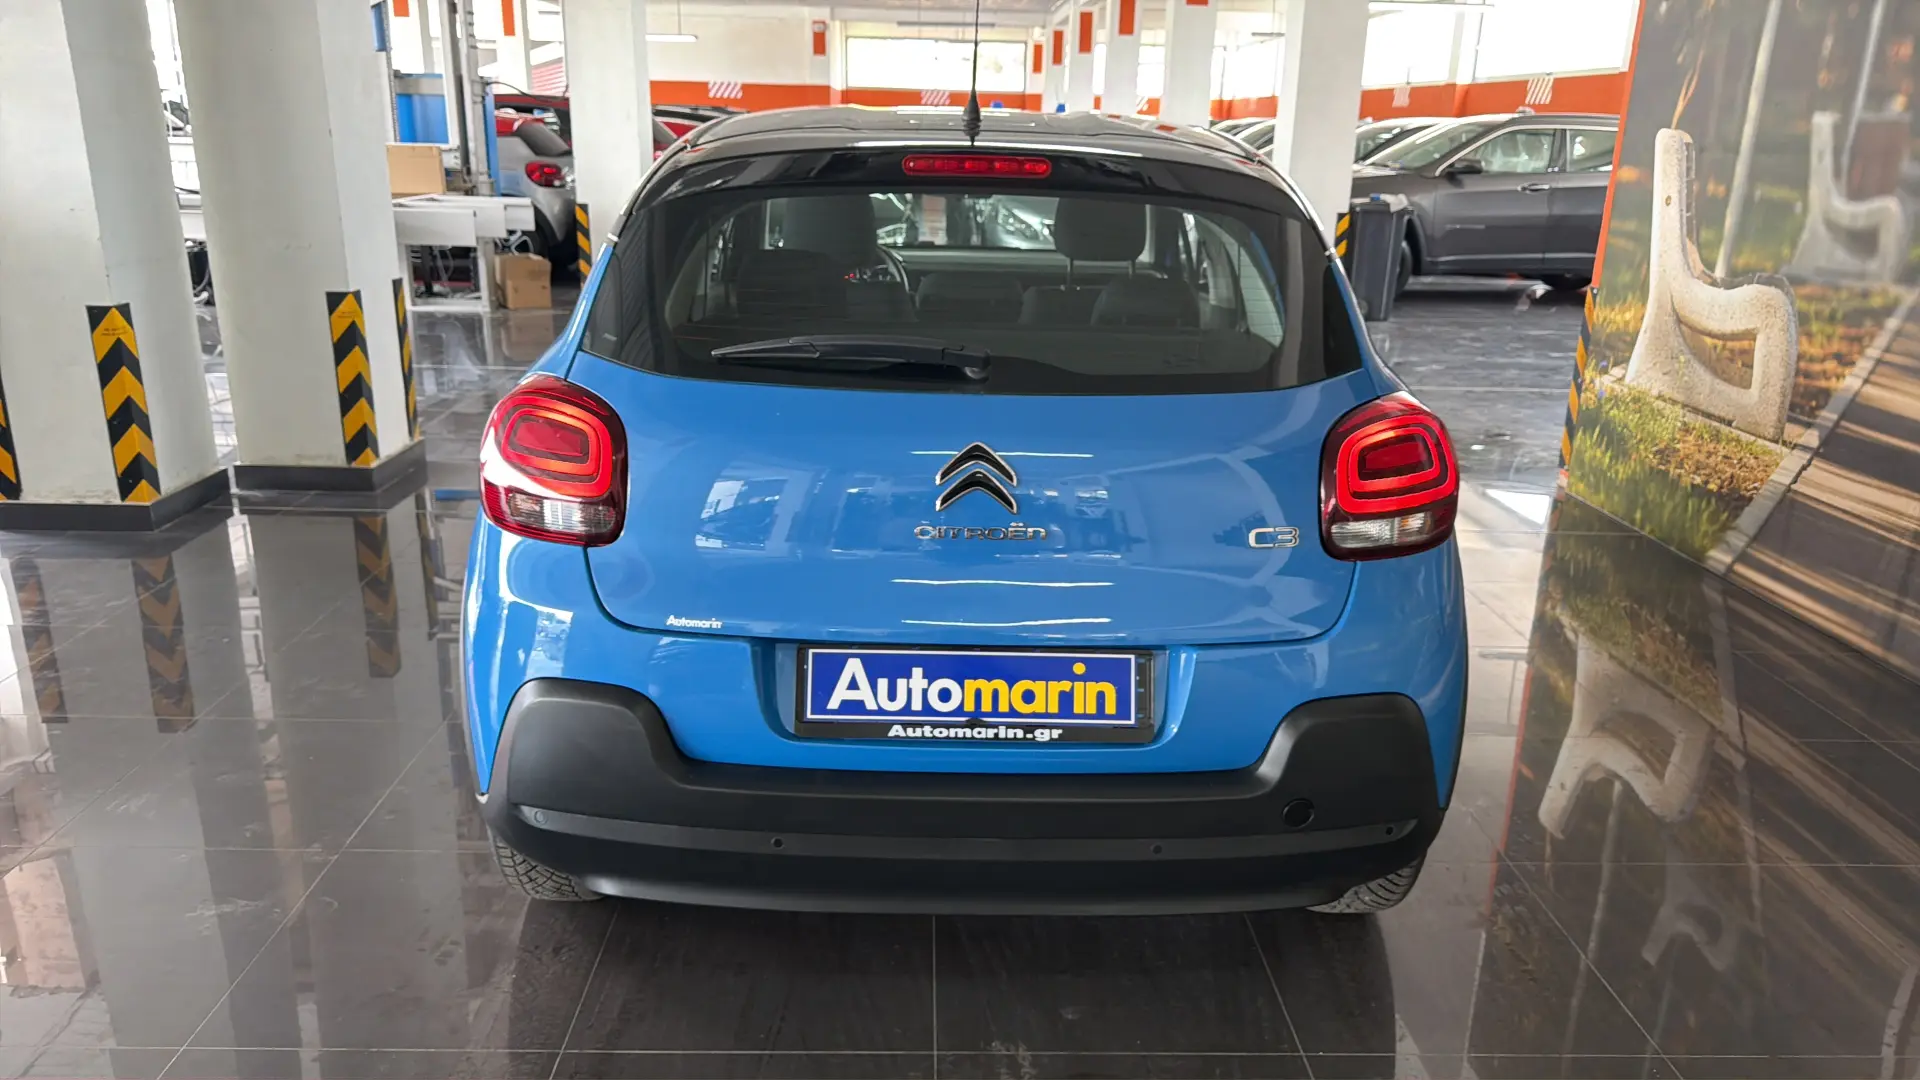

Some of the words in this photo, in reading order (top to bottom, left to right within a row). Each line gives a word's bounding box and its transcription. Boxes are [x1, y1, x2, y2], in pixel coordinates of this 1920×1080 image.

[1249, 527, 1299, 548] C3
[666, 615, 722, 628] Automarin
[826, 658, 1117, 715] Automarin
[887, 724, 1063, 742] Automarin.gr
